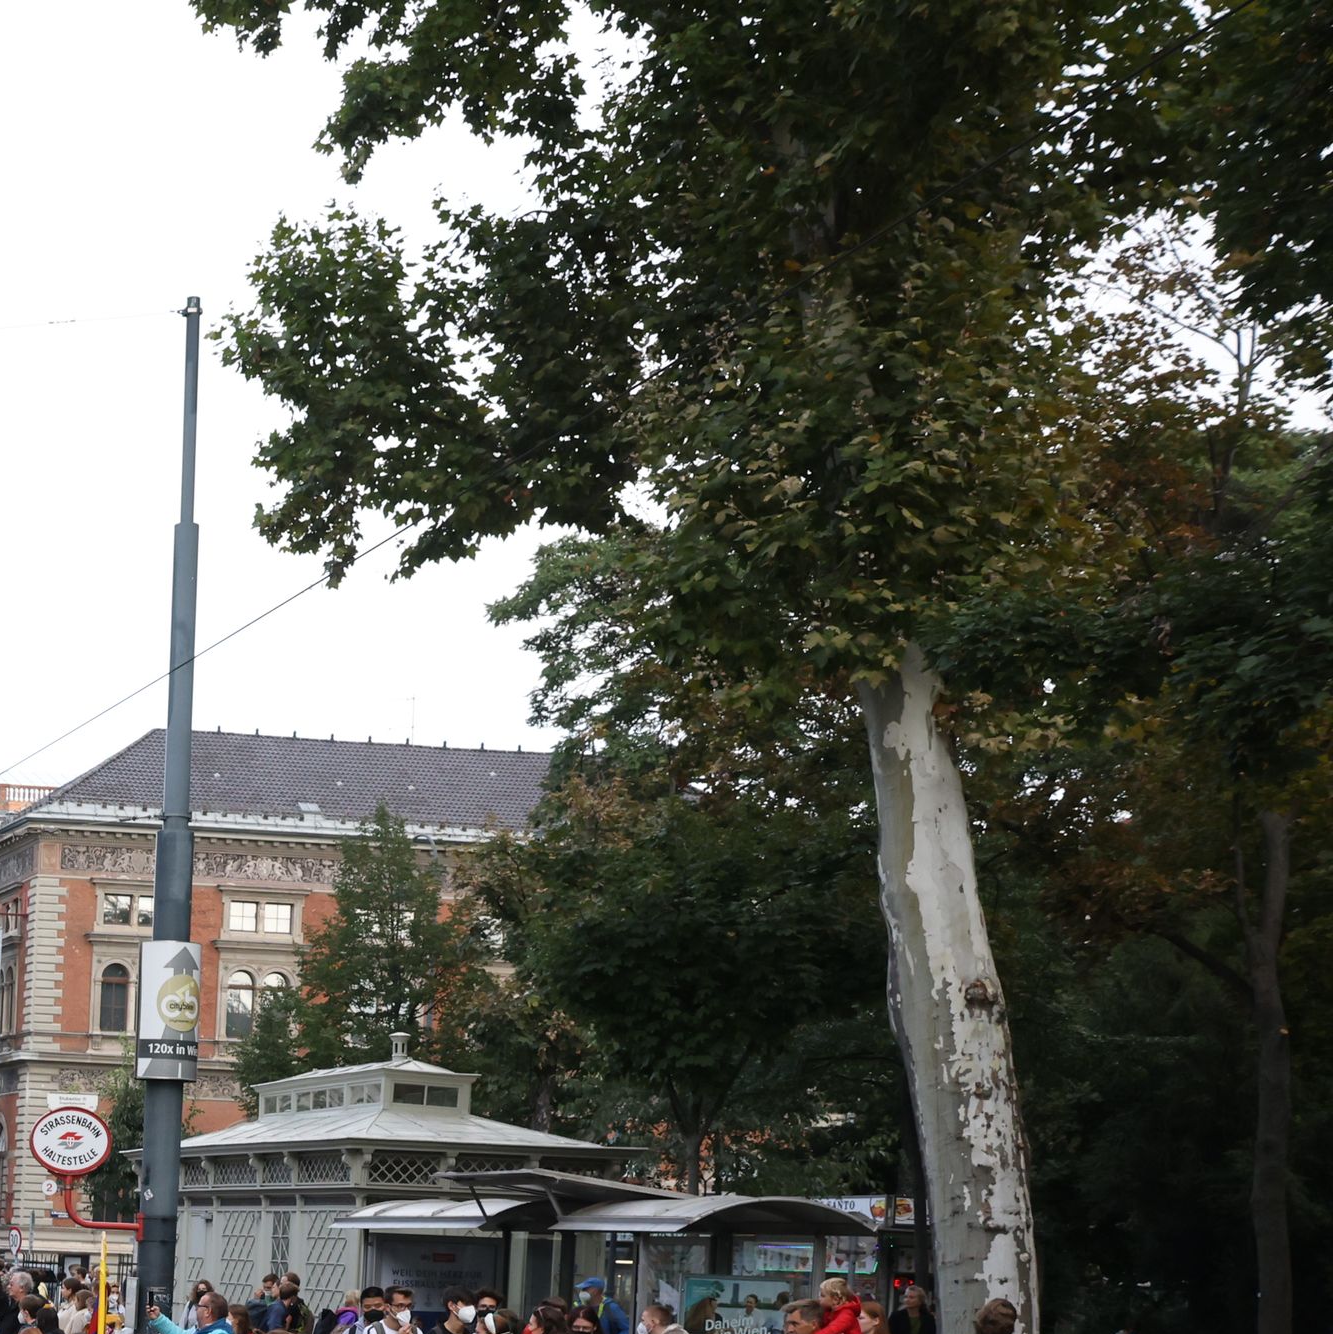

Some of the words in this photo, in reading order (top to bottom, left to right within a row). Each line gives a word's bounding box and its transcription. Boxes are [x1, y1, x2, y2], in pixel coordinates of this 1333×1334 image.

[148, 1043, 173, 1055] 120x
[176, 1044, 186, 1056] in
[187, 1045, 198, 1057] Wi
[40, 1115, 102, 1139] STRASSENBAHN
[41, 1145, 99, 1167] HALTESTELLE
[46, 1183, 53, 1193] 2
[10, 1232, 19, 1248] 30
[705, 1314, 754, 1332] Daheim
